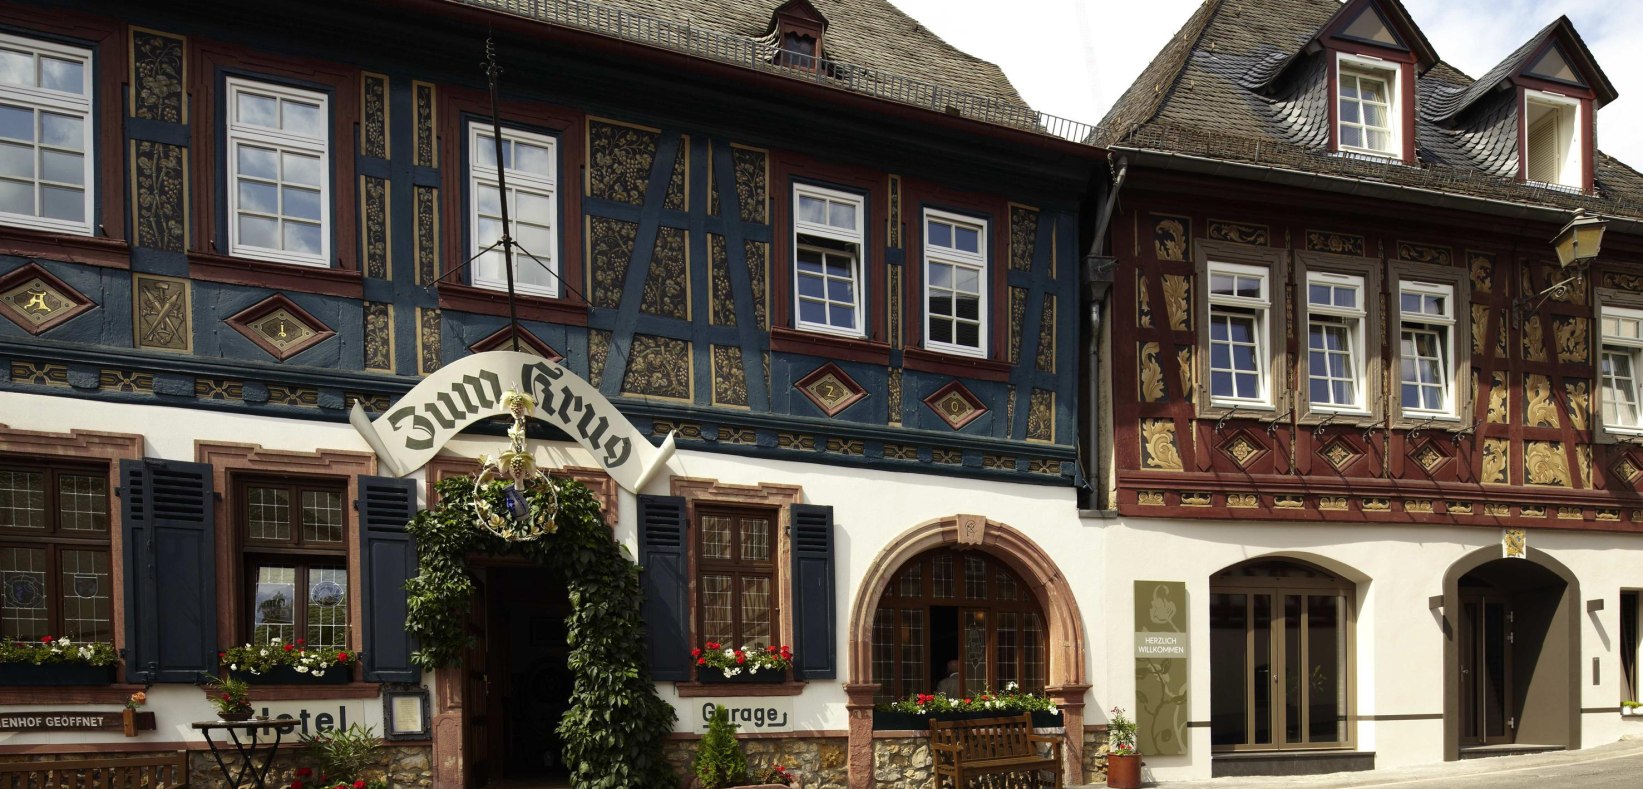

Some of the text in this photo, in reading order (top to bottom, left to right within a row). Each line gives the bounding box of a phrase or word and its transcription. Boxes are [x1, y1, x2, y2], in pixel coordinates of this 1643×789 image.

[387, 361, 632, 468] Zum Krug
[1145, 636, 1177, 645] HERZLICH
[1137, 645, 1184, 654] WILLKOMMEN
[0, 714, 104, 728] ENHOF GEÖFFNET
[702, 702, 778, 728] Grage
